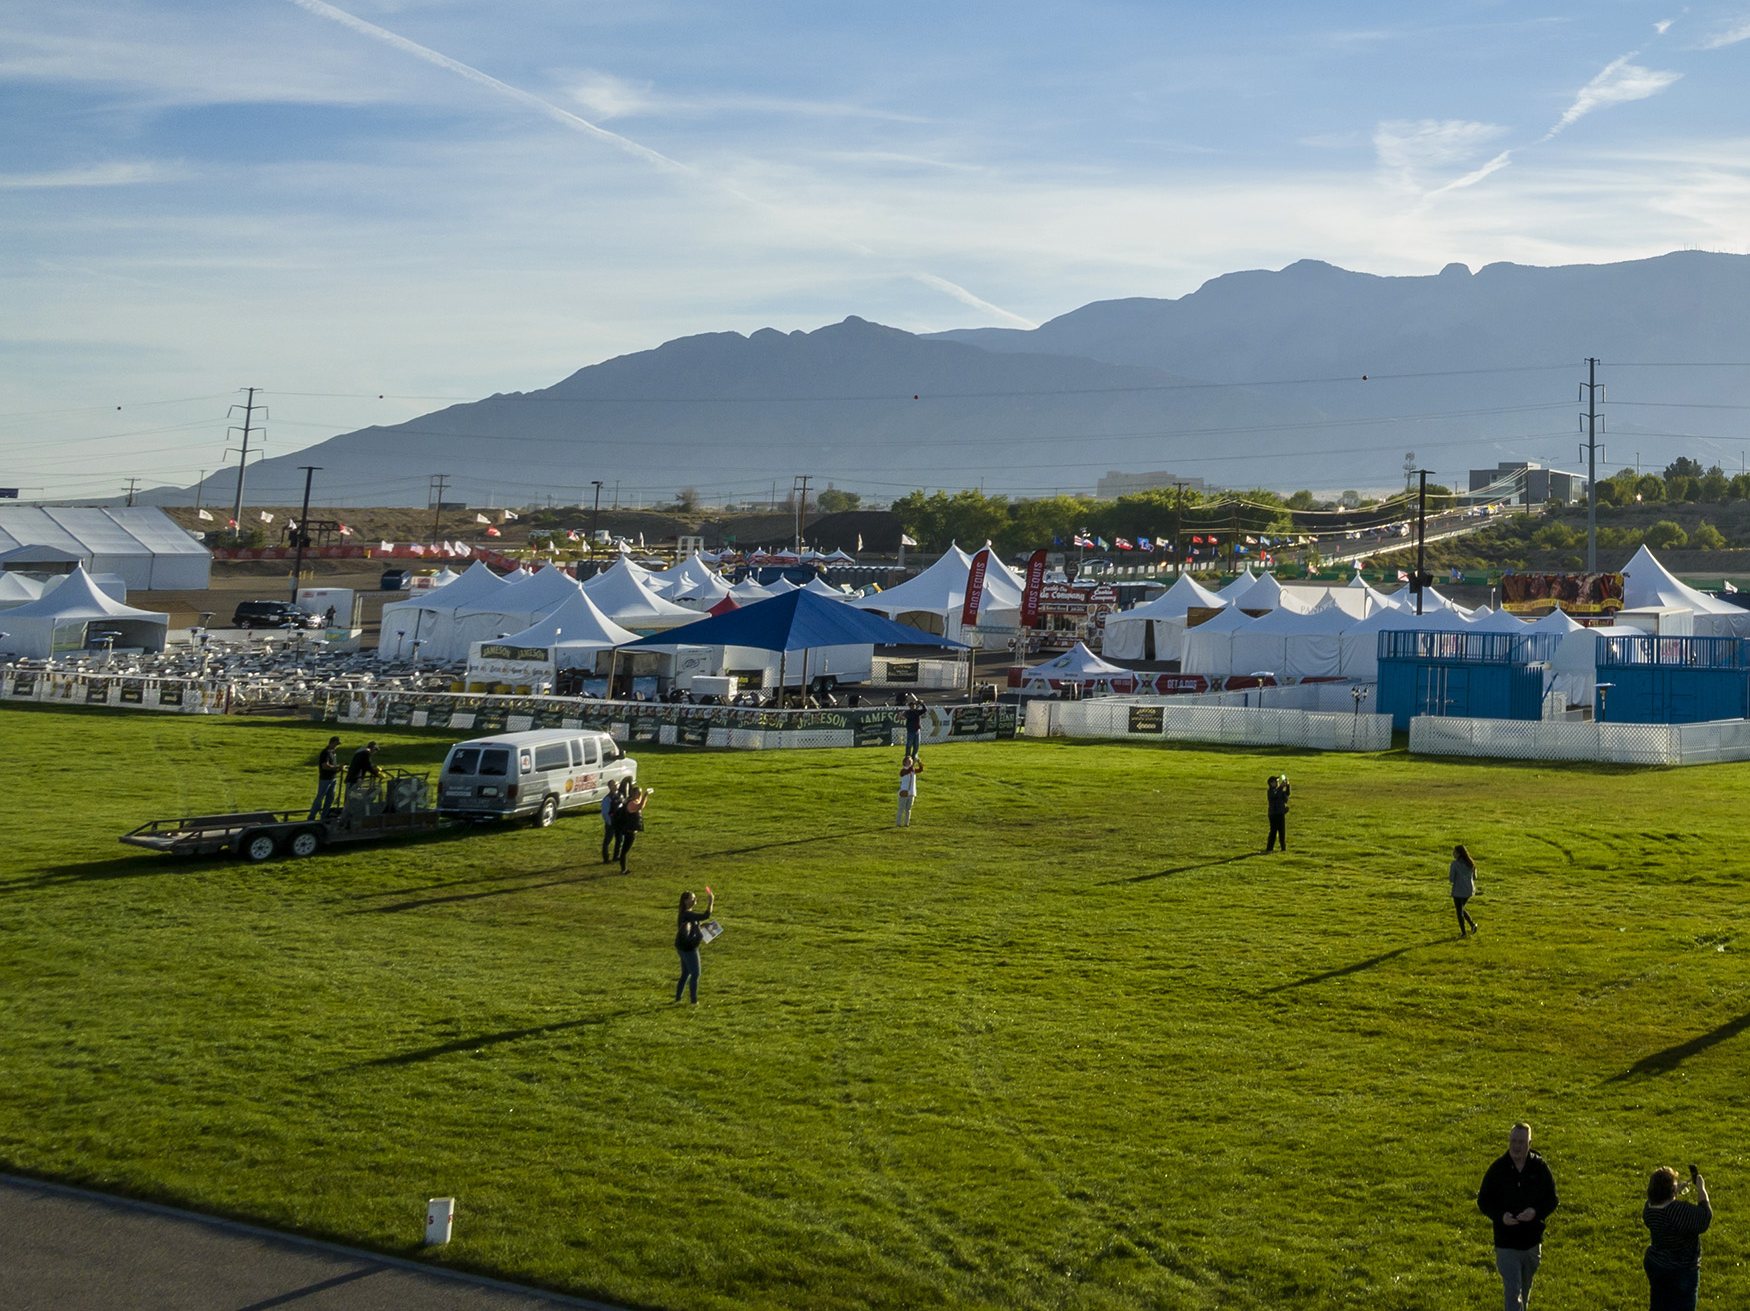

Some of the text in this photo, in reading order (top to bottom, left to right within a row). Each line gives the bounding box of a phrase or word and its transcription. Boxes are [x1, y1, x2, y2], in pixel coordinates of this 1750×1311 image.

[973, 562, 986, 589] EQUIS
[1030, 561, 1043, 589] EQUIS
[969, 591, 981, 609] DOS
[1027, 591, 1039, 609] DOS
